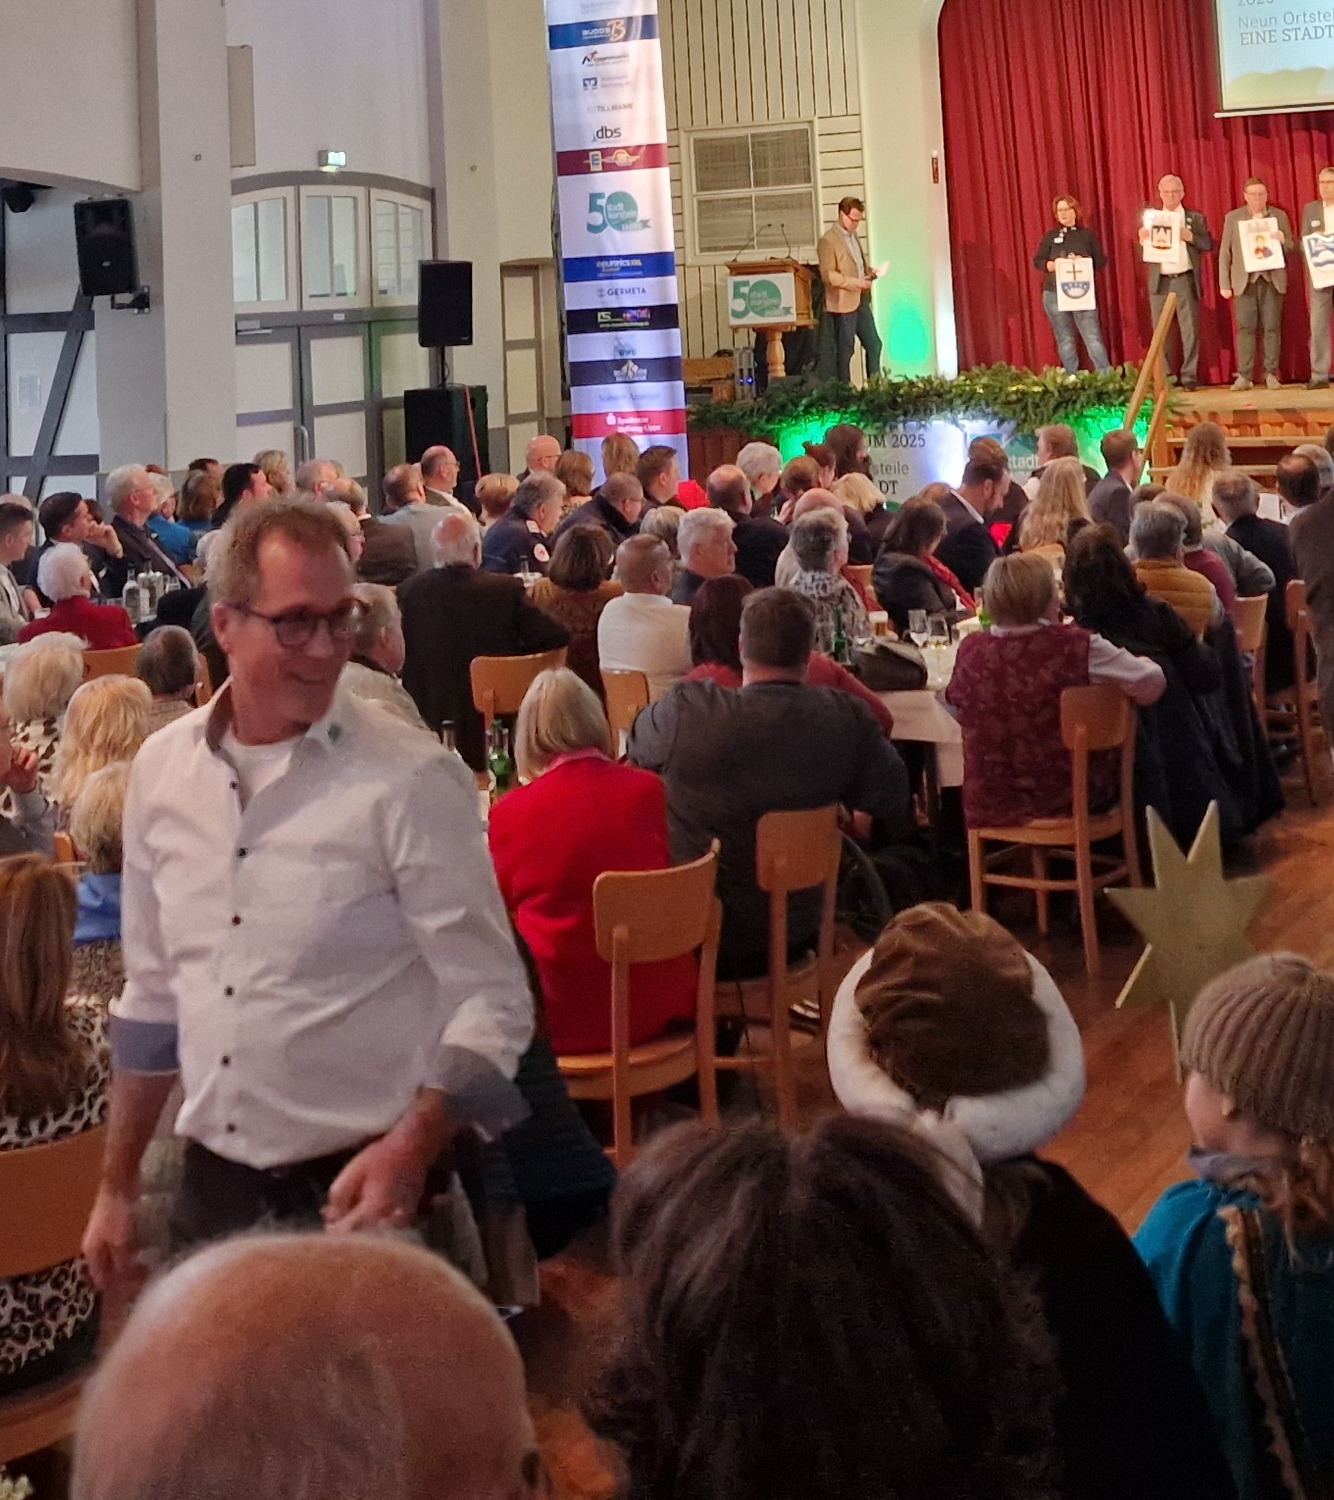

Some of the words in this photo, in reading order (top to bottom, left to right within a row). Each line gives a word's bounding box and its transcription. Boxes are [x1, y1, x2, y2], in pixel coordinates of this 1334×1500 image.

[1238, 14, 1277, 29] Neun
[1240, 29, 1277, 46] EINE
[1282, 24, 1334, 42] STADT
[596, 126, 622, 139] dbs
[587, 191, 638, 234] 50
[731, 279, 782, 319] 50
[892, 434, 926, 448] 2025
[873, 461, 909, 475] steile
